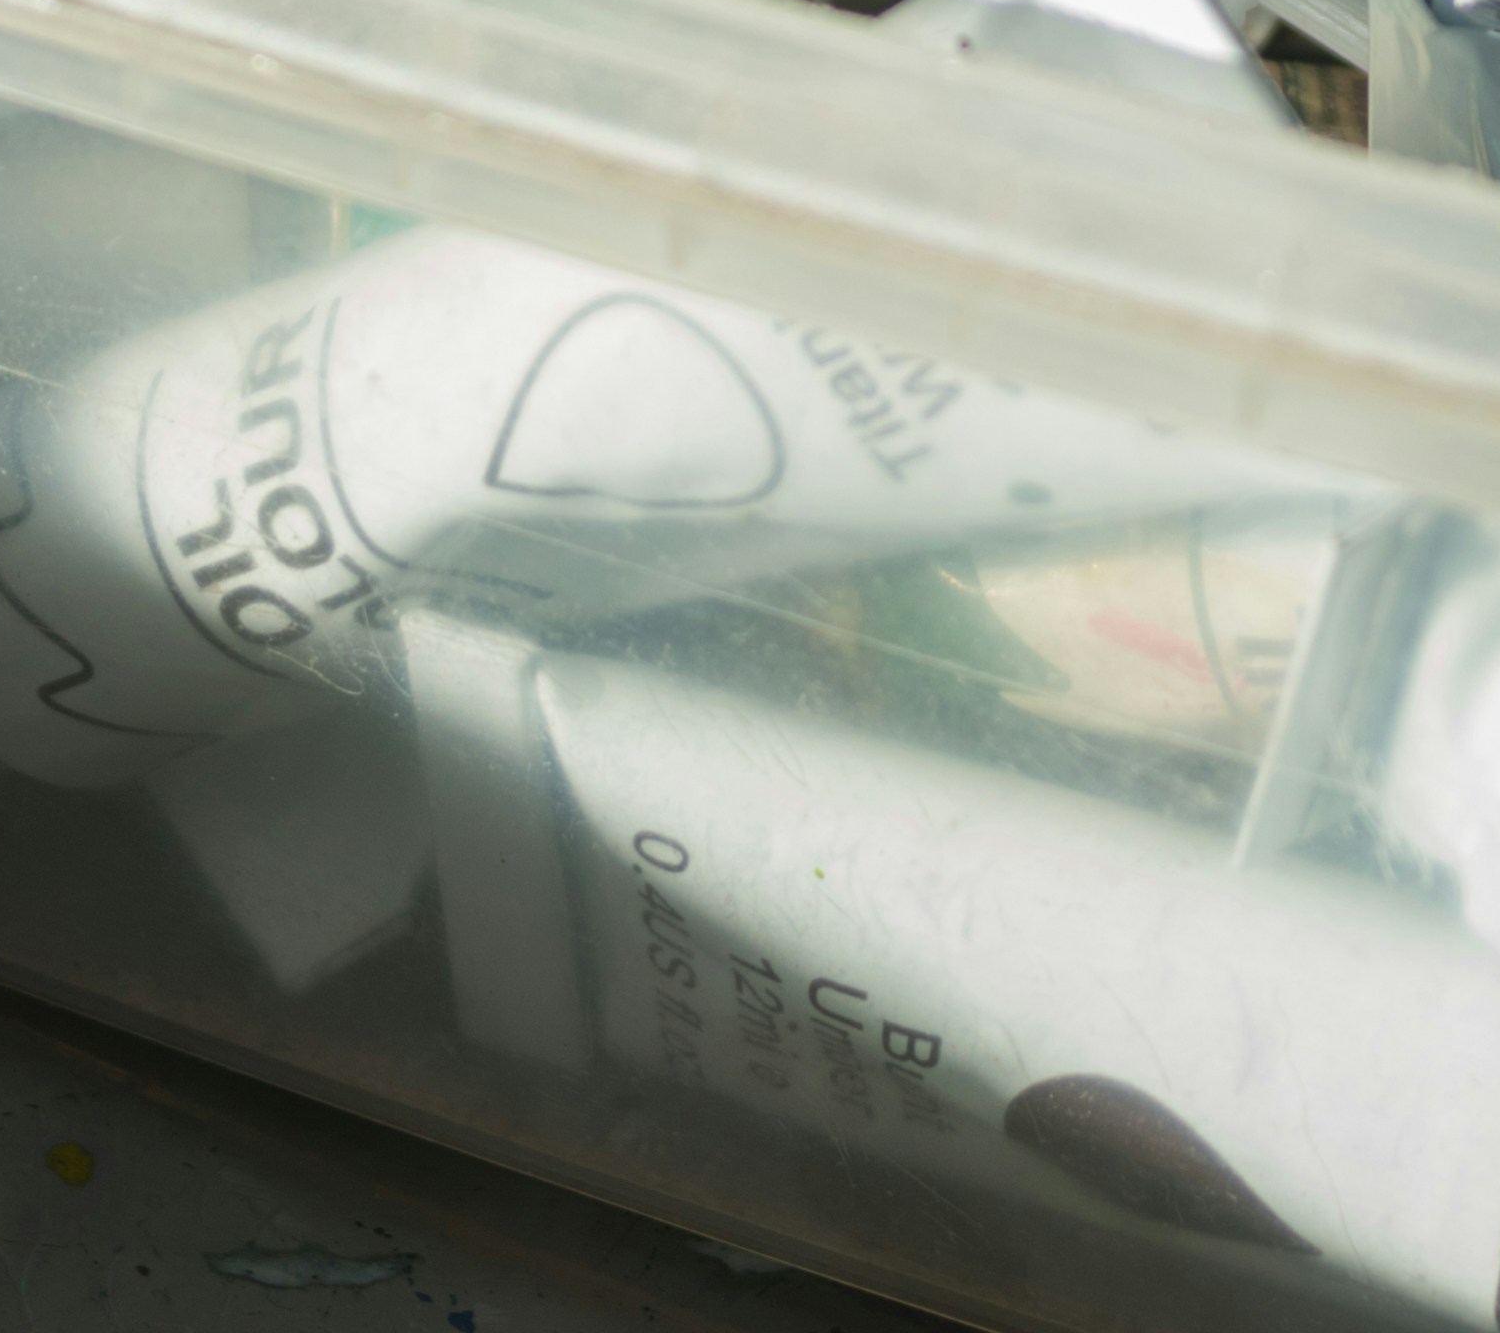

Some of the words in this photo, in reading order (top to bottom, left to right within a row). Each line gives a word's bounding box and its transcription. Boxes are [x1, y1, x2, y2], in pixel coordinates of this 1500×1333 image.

[775, 323, 935, 487] Titan
[175, 476, 313, 648] OIL
[633, 830, 700, 991] 0.4US
